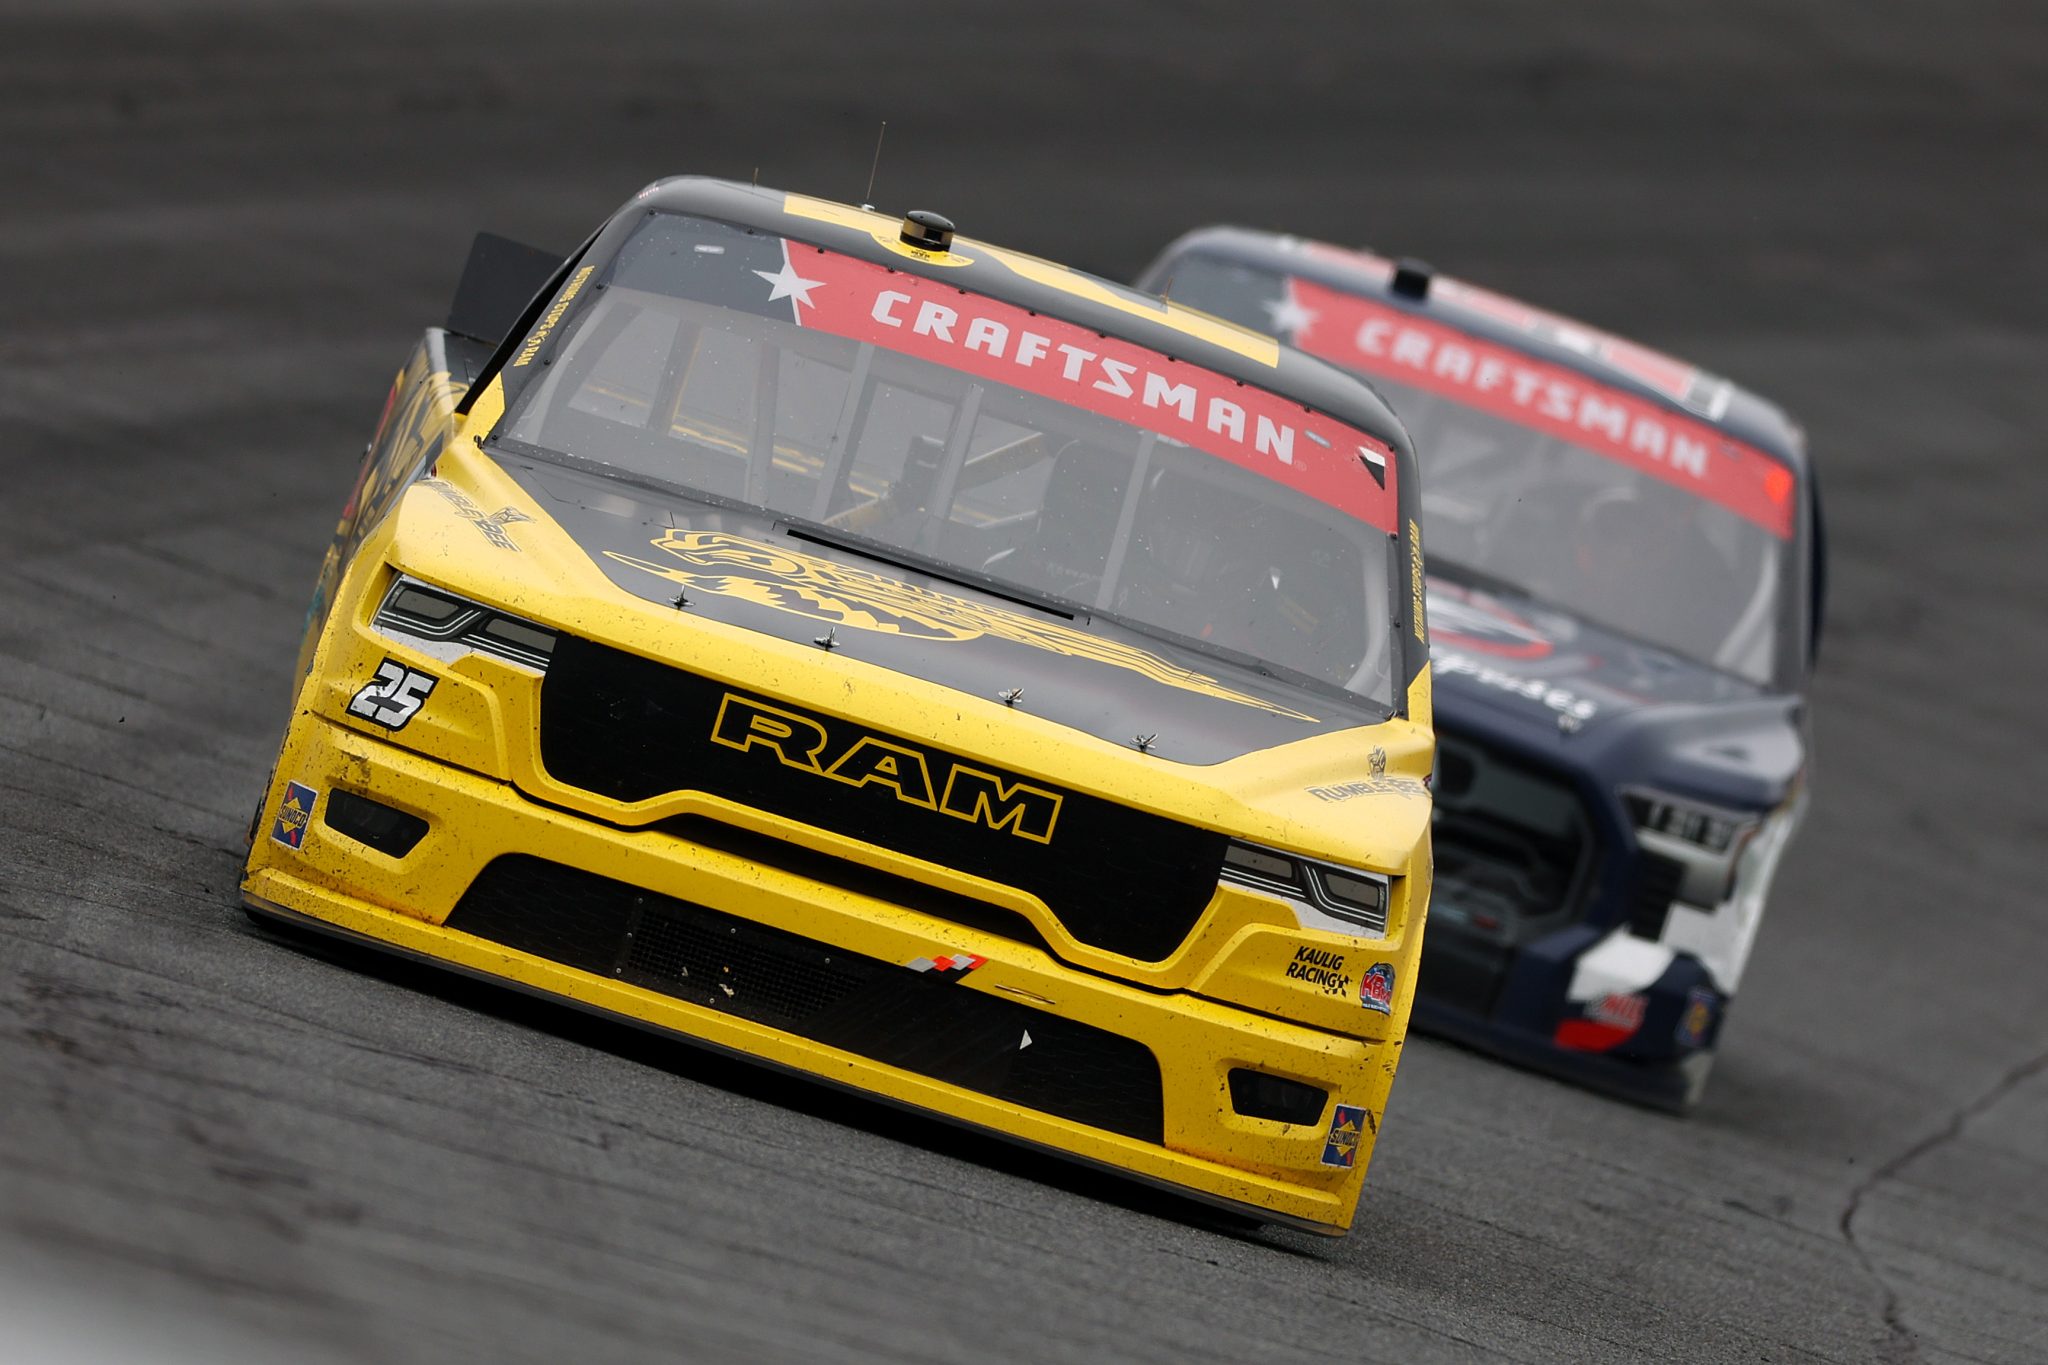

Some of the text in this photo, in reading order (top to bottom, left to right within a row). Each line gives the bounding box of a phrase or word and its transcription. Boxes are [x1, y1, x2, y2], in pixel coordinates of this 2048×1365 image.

[871, 289, 1295, 466] CRAFTSMAN
[1354, 317, 1709, 479] CRAFTSMAN
[345, 656, 440, 732] 25
[710, 692, 1063, 844] RAM
[1285, 961, 1338, 988] RACING
[1294, 945, 1345, 970] KAULIG
